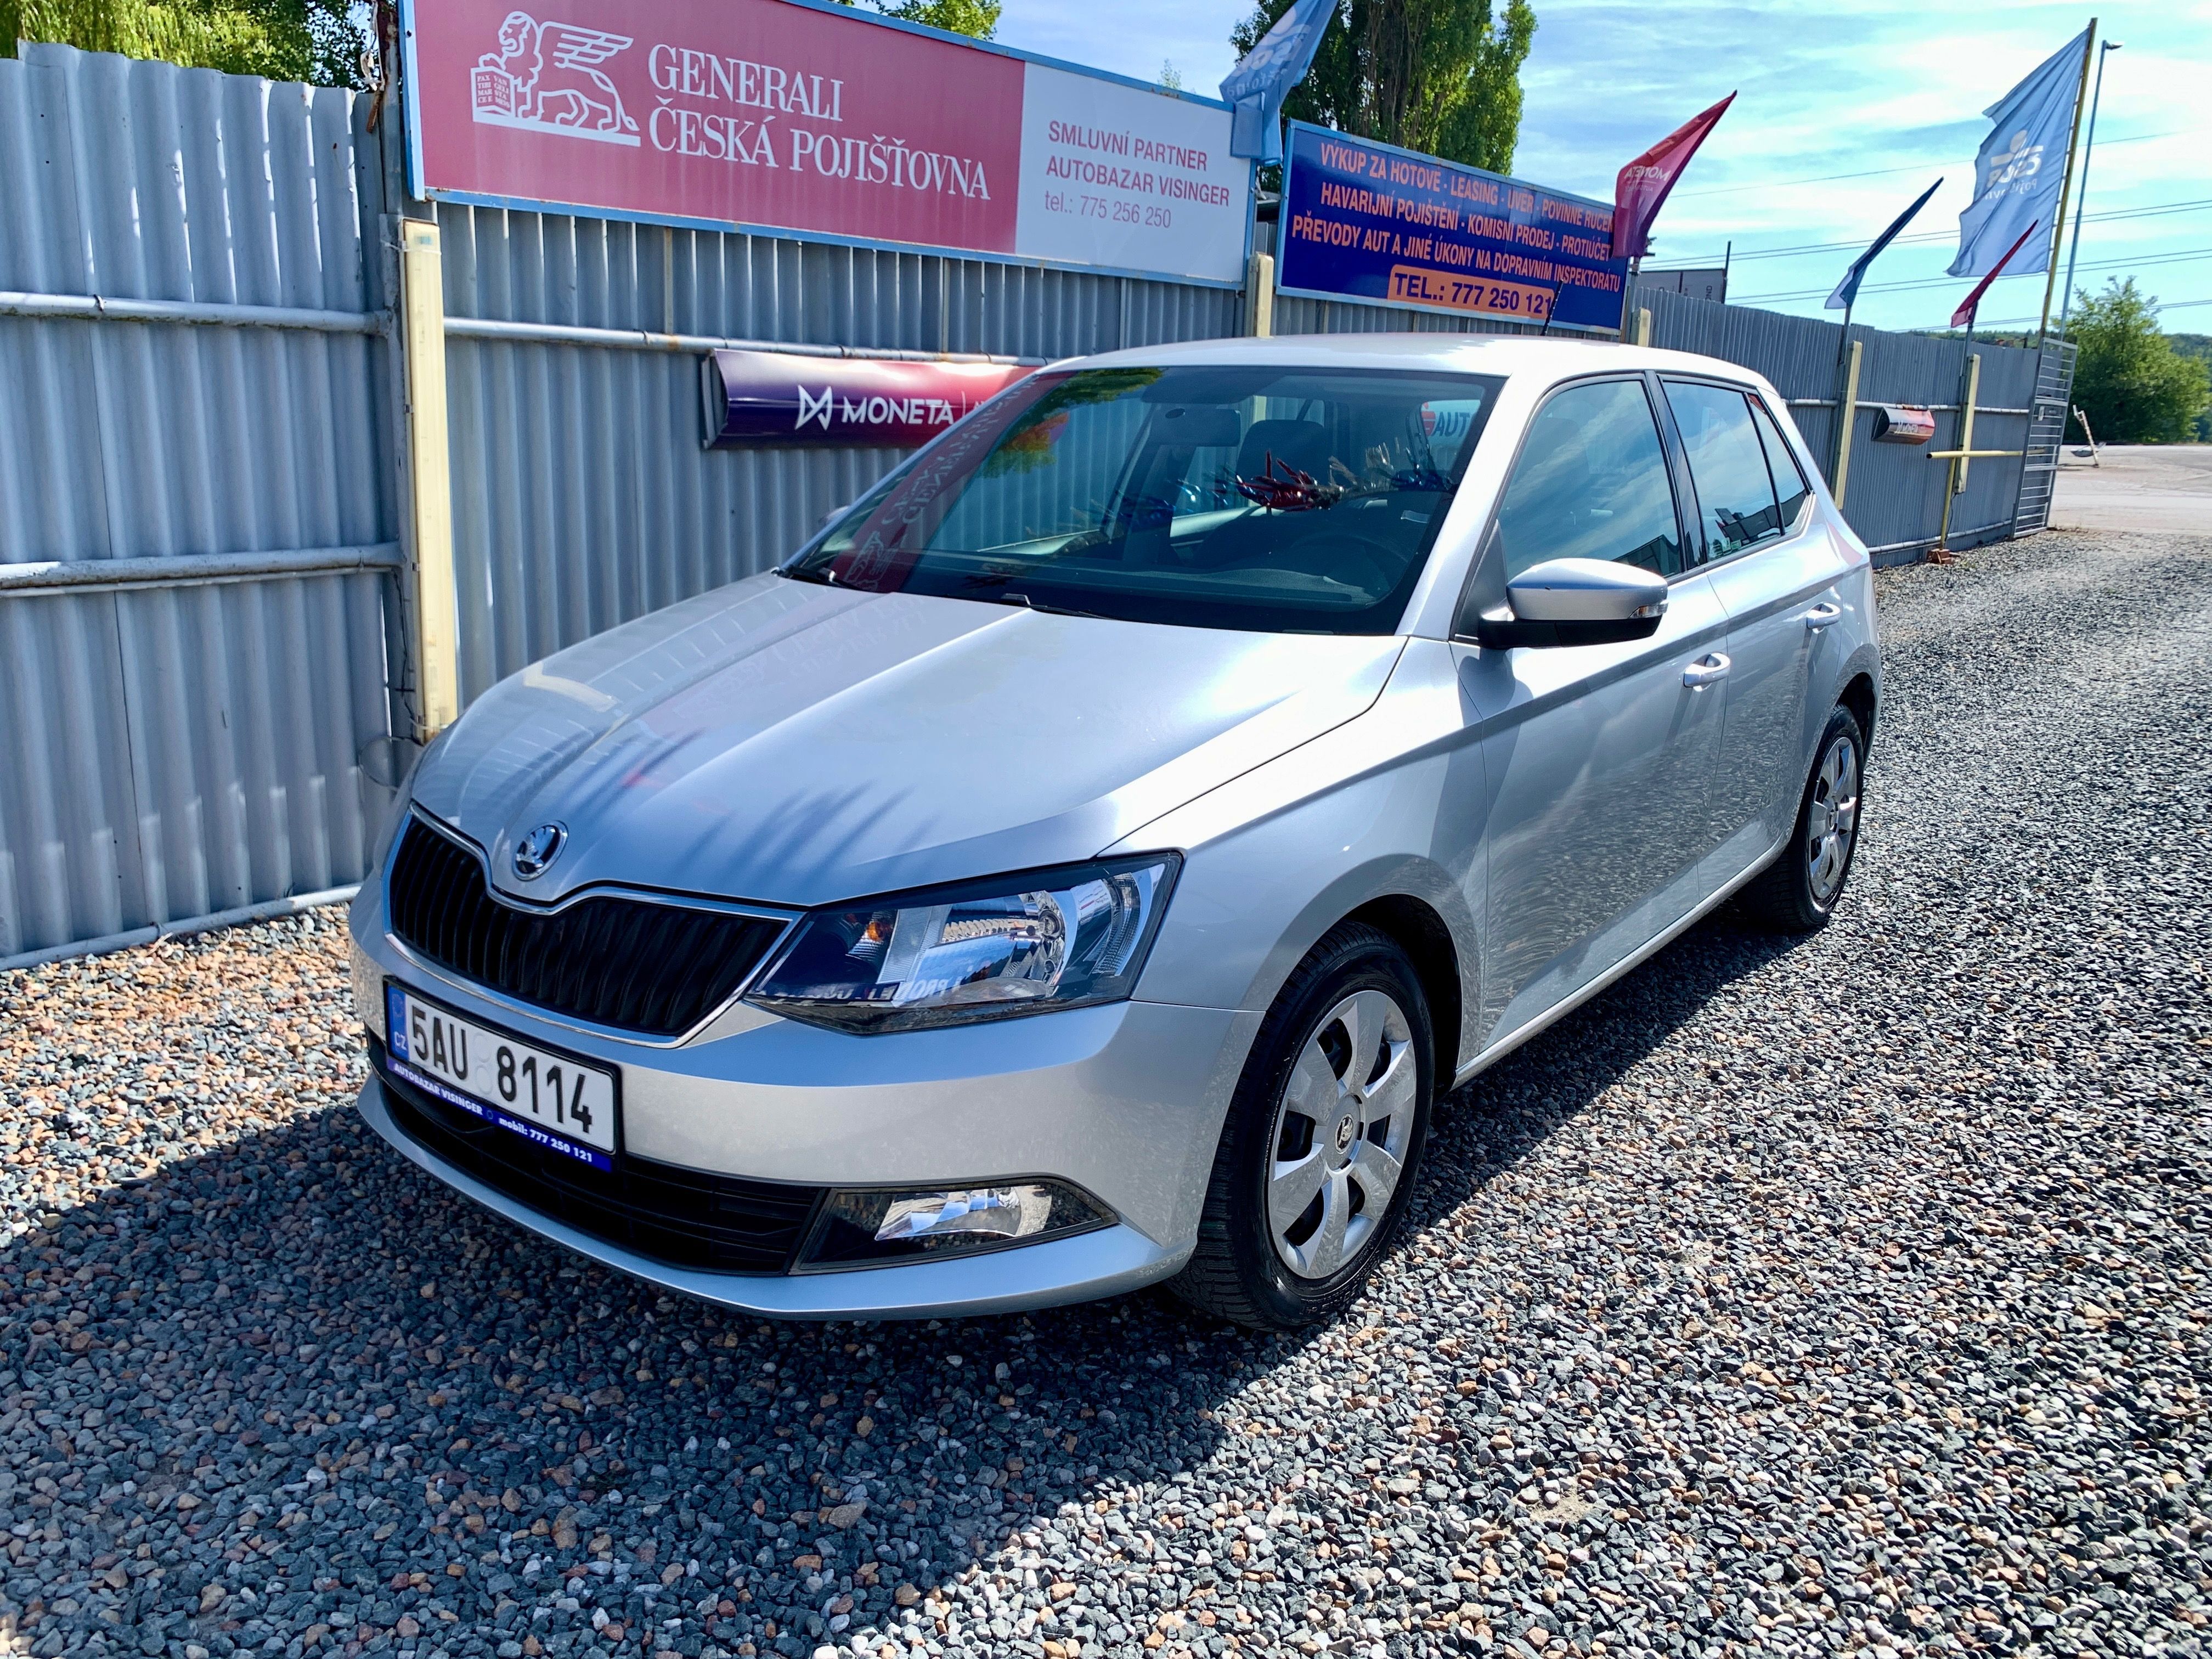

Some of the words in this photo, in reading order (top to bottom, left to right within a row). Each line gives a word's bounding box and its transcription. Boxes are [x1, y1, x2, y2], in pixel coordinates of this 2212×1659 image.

[648, 43, 844, 122] GENERALI
[649, 95, 779, 169] ČESKÁ
[789, 128, 991, 201] POJIŠŤOVNA
[1048, 120, 1130, 156] SMLUVNÍ
[1135, 138, 1207, 172] PARTNER
[1321, 139, 1366, 174] VÝKUP
[1369, 155, 1387, 180] ZA
[1451, 175, 1498, 206] LEASING
[1044, 189, 1073, 215] tel.:
[1080, 195, 1107, 219] 775
[1113, 200, 1140, 224] 256
[1145, 206, 1171, 229] 250
[1046, 155, 1154, 194] AUTOBAZAR
[1159, 176, 1230, 207] VISINGER
[1291, 210, 1361, 248] PŘEVODY
[1363, 230, 1390, 254] AUT
[1391, 233, 1401, 256] A
[1403, 230, 1432, 261] JINÉ
[1434, 235, 1474, 268] ÚKONY
[1476, 250, 1492, 270] NA
[1494, 252, 1552, 281] DOPRAVNÍM
[1554, 264, 1621, 293] INSPEKTORÁTU
[1321, 181, 1395, 218] HAVARIJNÍ
[1396, 197, 1461, 230] POJIŠTĚNÍ
[1515, 224, 1555, 251] PRODEJ
[1561, 234, 1611, 262] PROTIÚČET
[1394, 273, 1444, 301] TEL.:
[1452, 282, 1485, 306] 777
[1488, 286, 1520, 313] 250
[1526, 294, 1551, 314] 121
[842, 396, 954, 426] MONETA
[393, 1032, 407, 1051] CZ
[411, 1005, 469, 1081] 5AU
[496, 1046, 593, 1134] 8114
[394, 1063, 440, 1096] AUTOBAZAR
[441, 1088, 484, 1116] VISINGER
[499, 1116, 528, 1137] mobil:
[529, 1127, 549, 1144] 777
[551, 1137, 571, 1153] 250
[573, 1146, 592, 1163] 121
